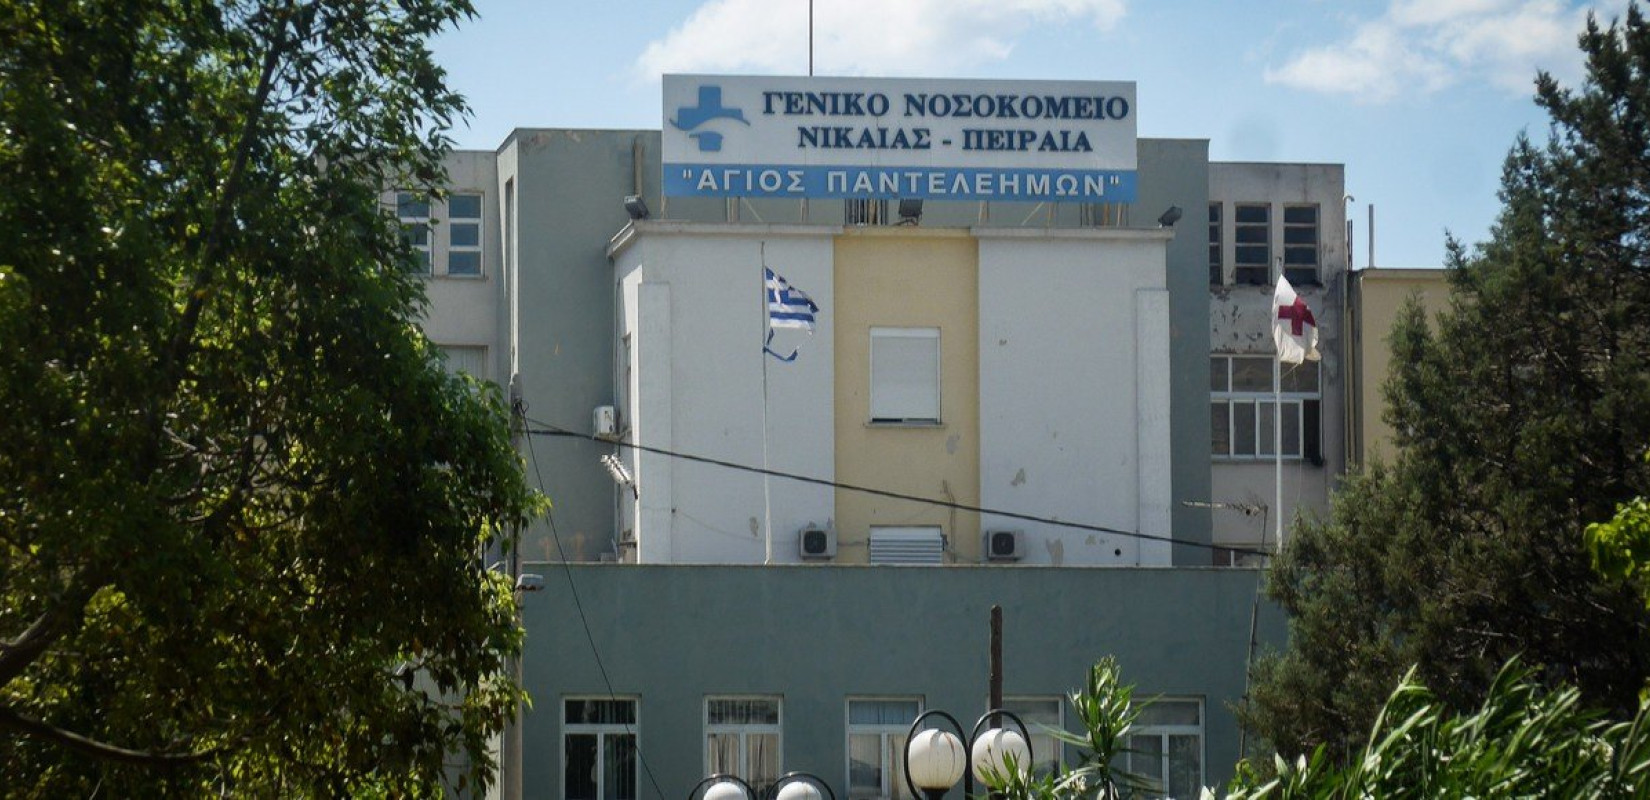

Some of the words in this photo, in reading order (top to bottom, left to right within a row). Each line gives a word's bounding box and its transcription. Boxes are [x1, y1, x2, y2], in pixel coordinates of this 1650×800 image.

[762, 91, 890, 117] ΓΕΝΙΚΟ
[903, 94, 1129, 120] ΝΟΣΟΚΟΜΕΙΟ
[797, 126, 932, 150] ΝΙΚΑΙΑΣ
[962, 129, 1093, 153] ΠΕΙΡΑΙΑ
[682, 168, 805, 193] "ΑΓΙΟΣ
[827, 170, 1120, 197] ΠΑΝΤΕΛΕΗΜΩΝ"
